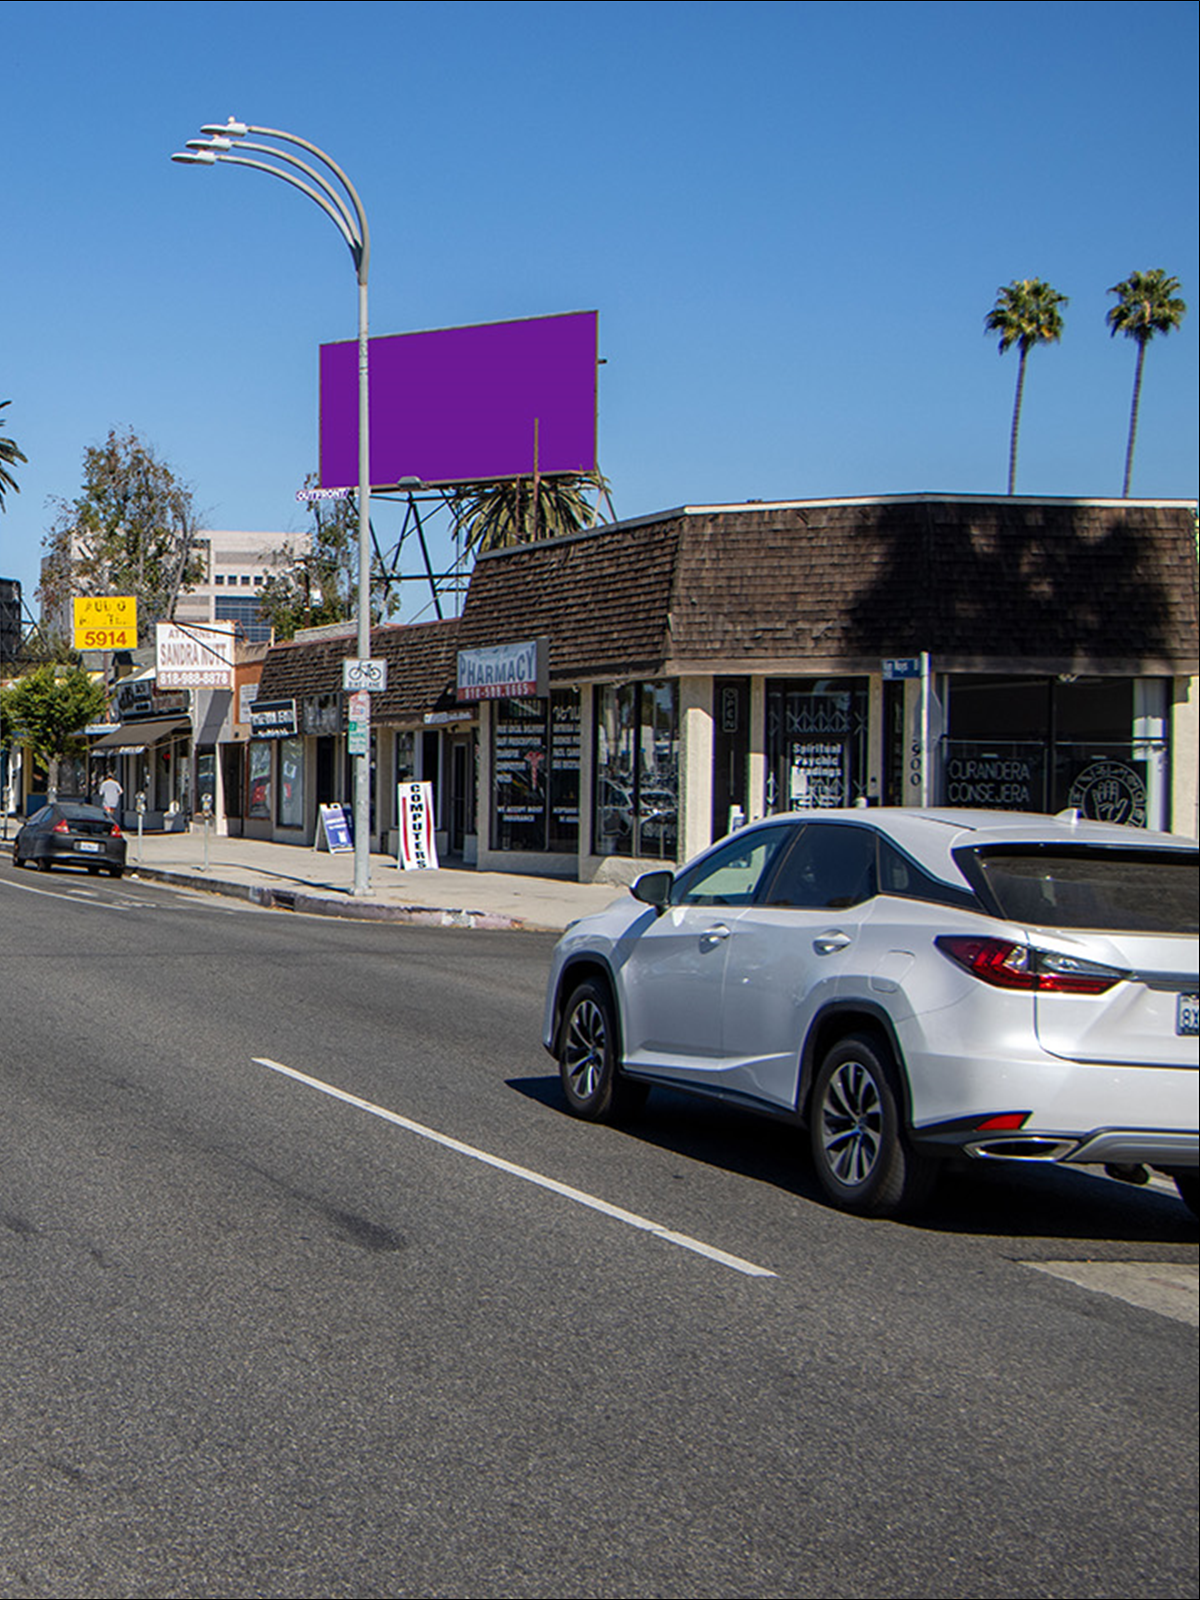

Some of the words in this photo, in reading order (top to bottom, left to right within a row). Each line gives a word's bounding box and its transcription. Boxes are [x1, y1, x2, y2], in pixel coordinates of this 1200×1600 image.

[84, 631, 127, 647] 5914
[161, 643, 199, 665] SANDRA
[460, 644, 535, 685] PHARMACY
[793, 742, 841, 755] Spiritual
[794, 755, 839, 767] Psychic
[910, 739, 922, 787] 900
[949, 759, 1030, 781] CURANDERA
[949, 781, 1030, 802] CONSEJERA
[409, 784, 427, 868] COMPUTERS
